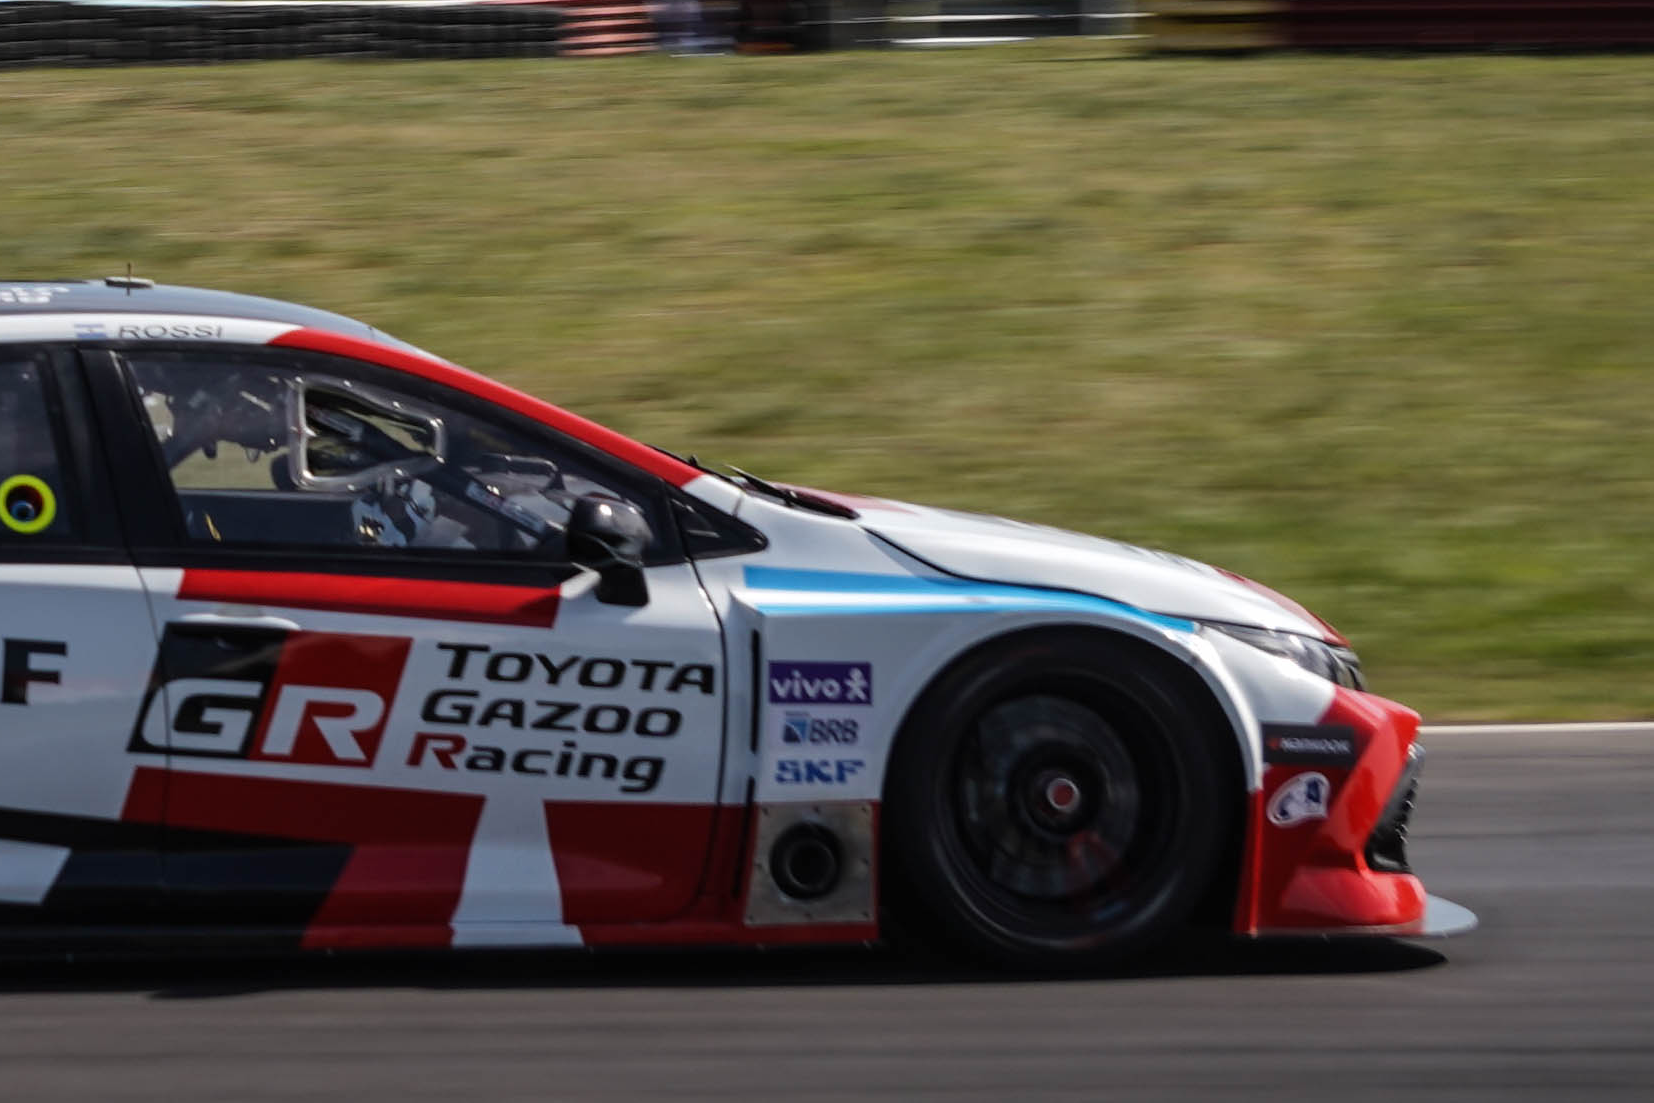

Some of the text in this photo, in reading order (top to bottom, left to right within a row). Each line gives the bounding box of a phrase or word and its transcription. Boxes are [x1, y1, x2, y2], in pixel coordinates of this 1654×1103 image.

[118, 324, 223, 339] ROSSI
[437, 642, 715, 695] TOYOTA
[770, 669, 841, 698] vivo
[141, 677, 386, 761] GR
[420, 689, 683, 737] GAZOO
[809, 719, 859, 743] BRB
[406, 732, 666, 793] Racing
[775, 760, 866, 784] SKF
